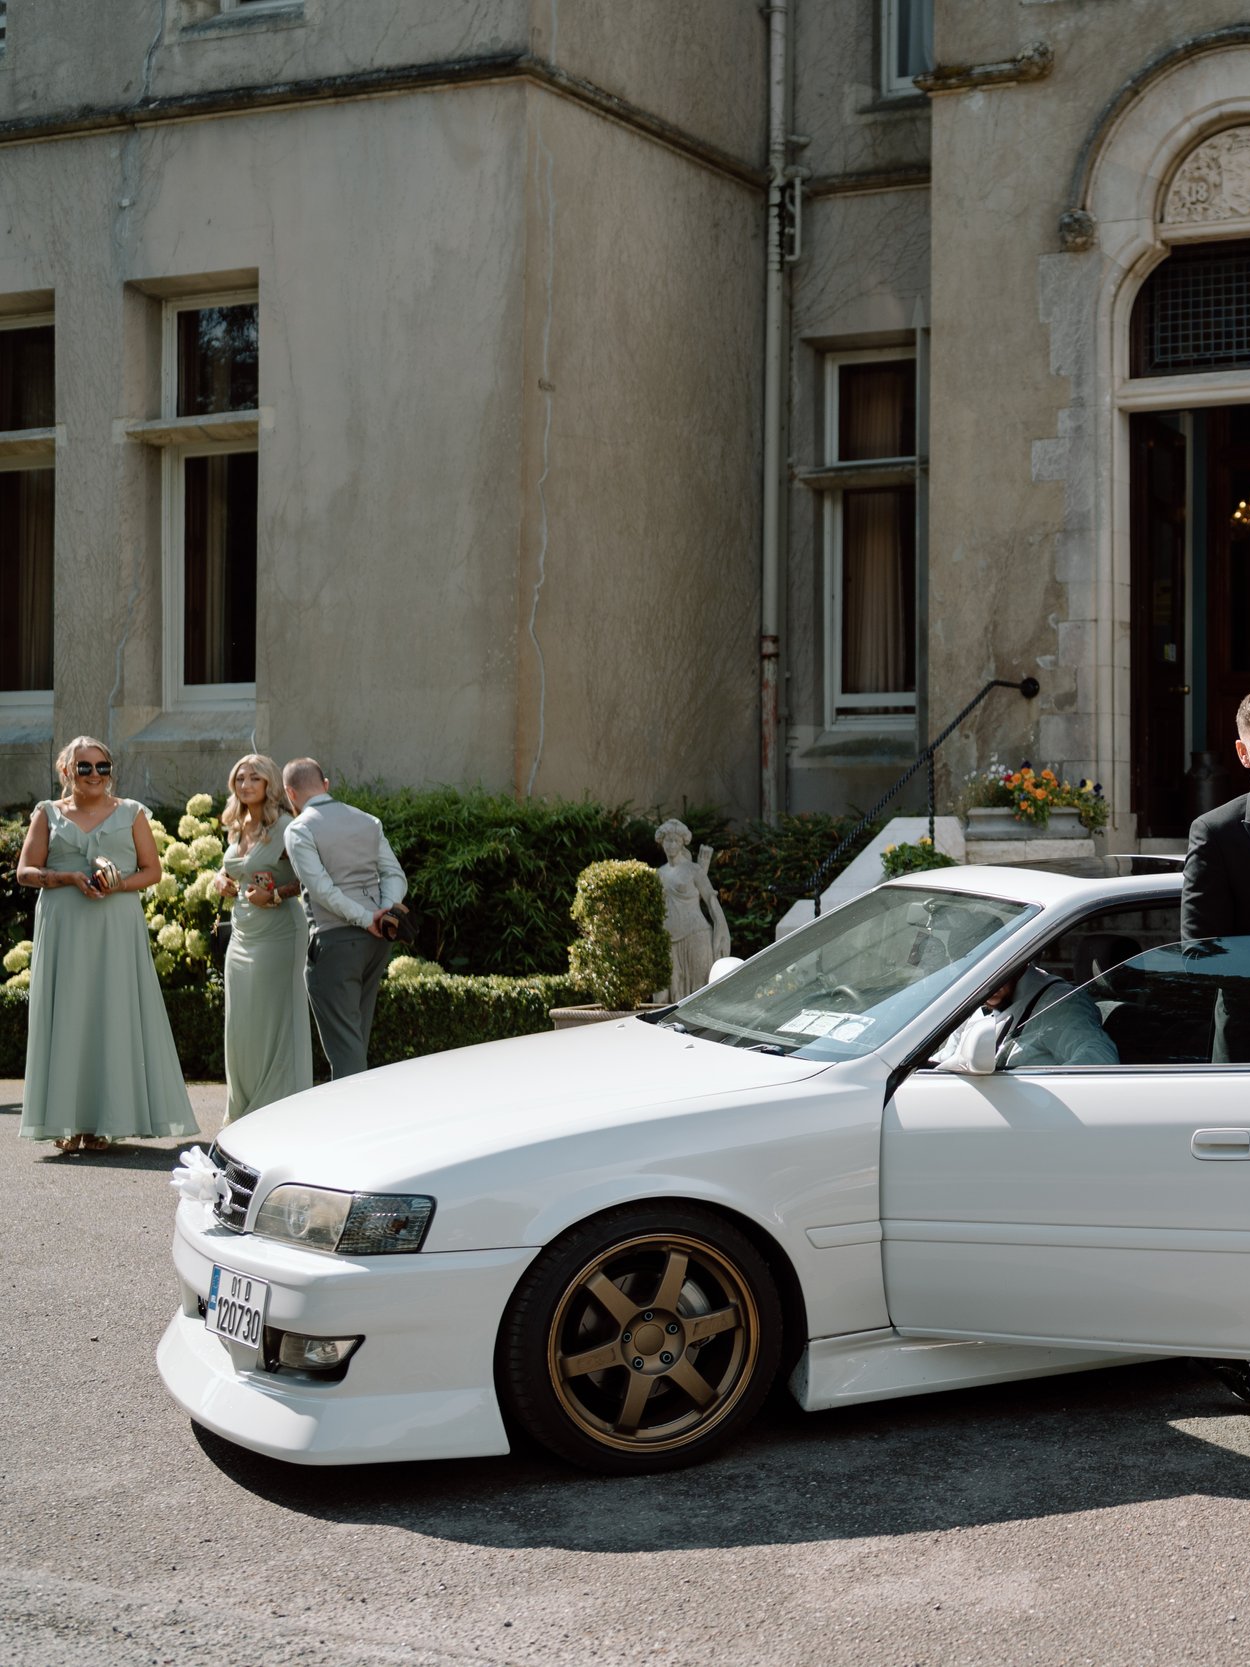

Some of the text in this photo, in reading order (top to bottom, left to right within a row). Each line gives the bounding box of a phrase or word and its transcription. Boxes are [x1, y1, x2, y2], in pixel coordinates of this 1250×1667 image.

[231, 1276, 242, 1299] 01
[245, 1281, 252, 1302] D
[217, 1297, 261, 1344] 120730
